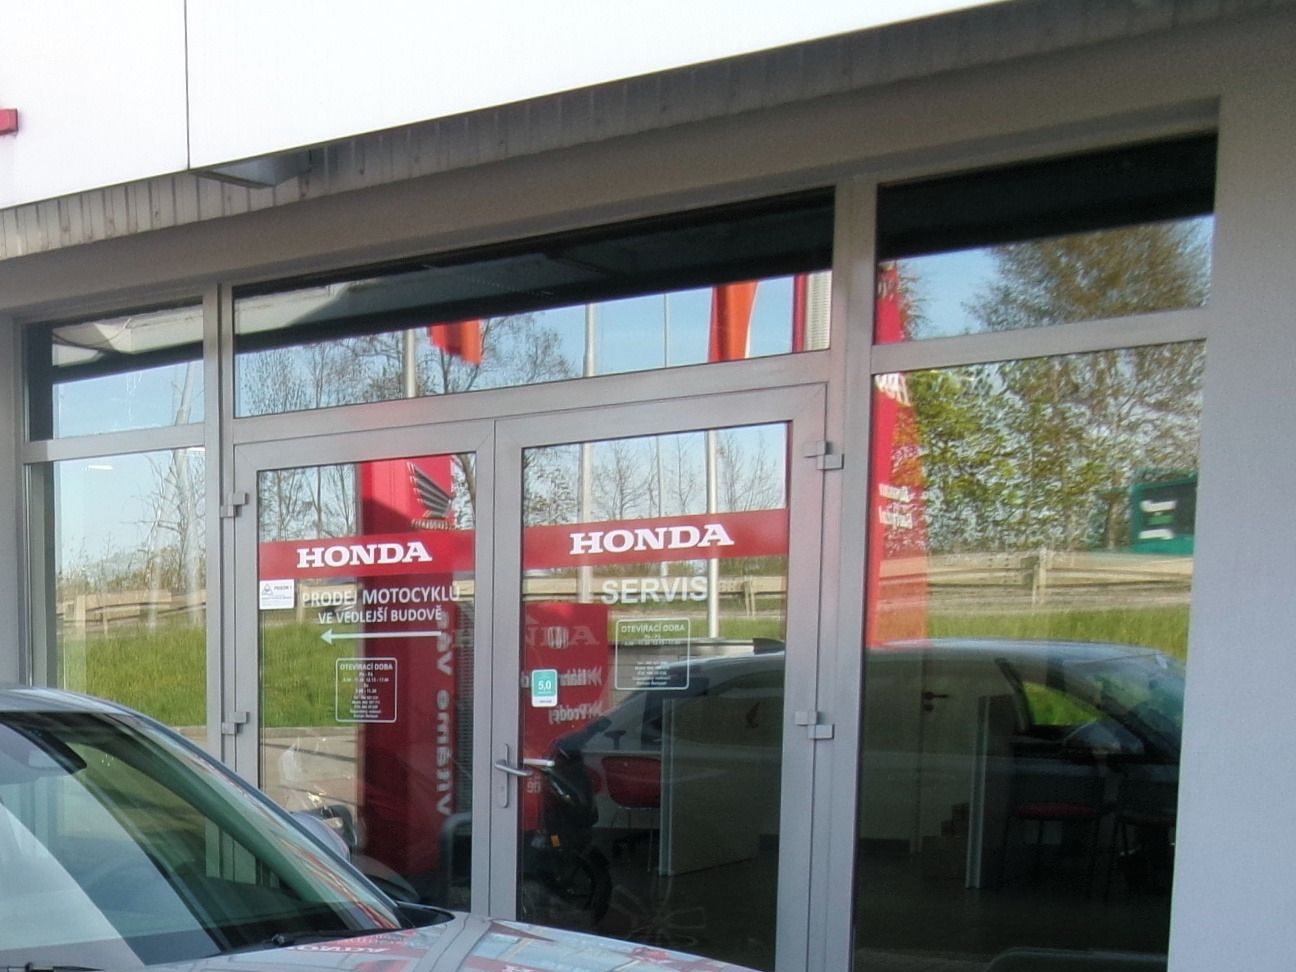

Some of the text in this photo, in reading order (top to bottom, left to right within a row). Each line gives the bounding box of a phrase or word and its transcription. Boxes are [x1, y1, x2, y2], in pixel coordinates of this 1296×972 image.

[570, 523, 735, 555] HONDA
[297, 542, 432, 569] HONDA
[303, 581, 461, 608] PRODEJ MOTOCYKLŮ
[601, 576, 708, 605] SERVIS
[318, 605, 442, 625] VE VEDLEJŠÍ BUDOVĚ
[538, 680, 552, 692] 5,0
